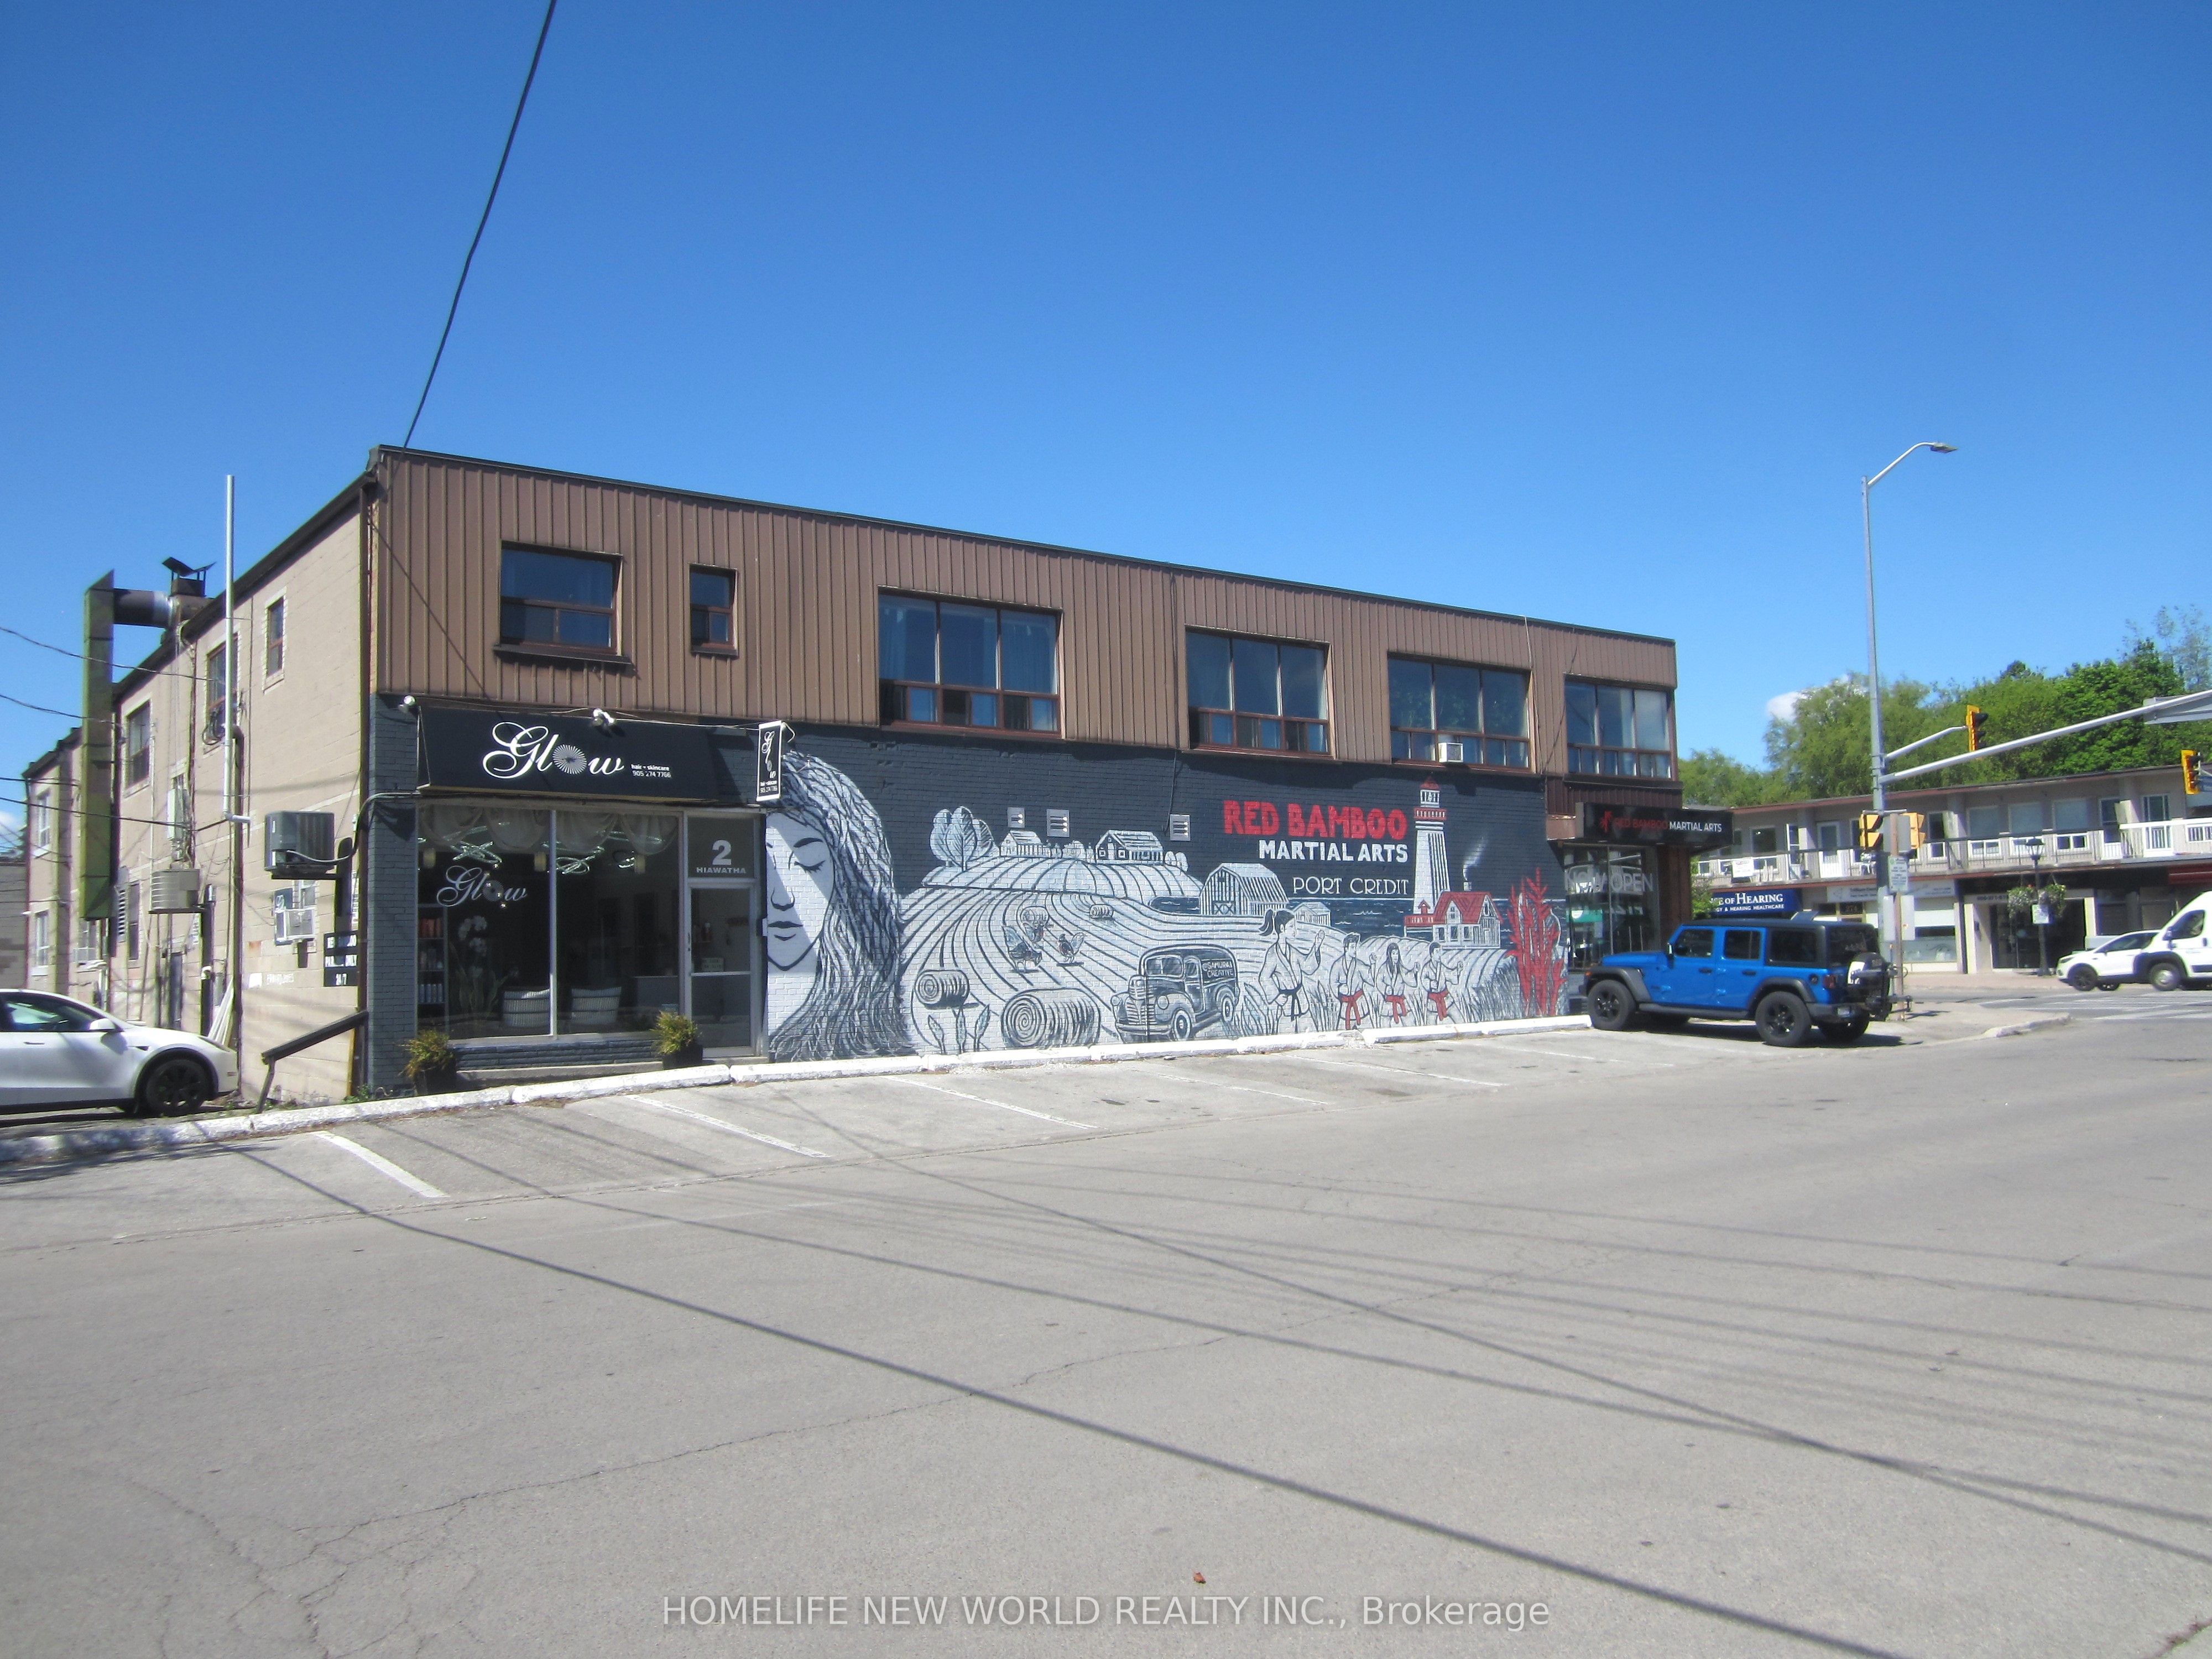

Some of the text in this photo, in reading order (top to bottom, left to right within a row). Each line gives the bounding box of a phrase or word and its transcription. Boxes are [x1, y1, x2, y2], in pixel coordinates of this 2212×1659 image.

[483, 722, 624, 779] Glow
[1224, 800, 1408, 840] RED BAMBOO
[1615, 818, 1722, 832] RED BAMBOO MARTIAL ARTS
[712, 839, 732, 865] 2
[1259, 840, 1408, 863] MARTIAL ARTS
[436, 865, 528, 907] Glow
[1293, 877, 1408, 895] PORT CREDIT
[1611, 872, 1654, 894] OPEN
